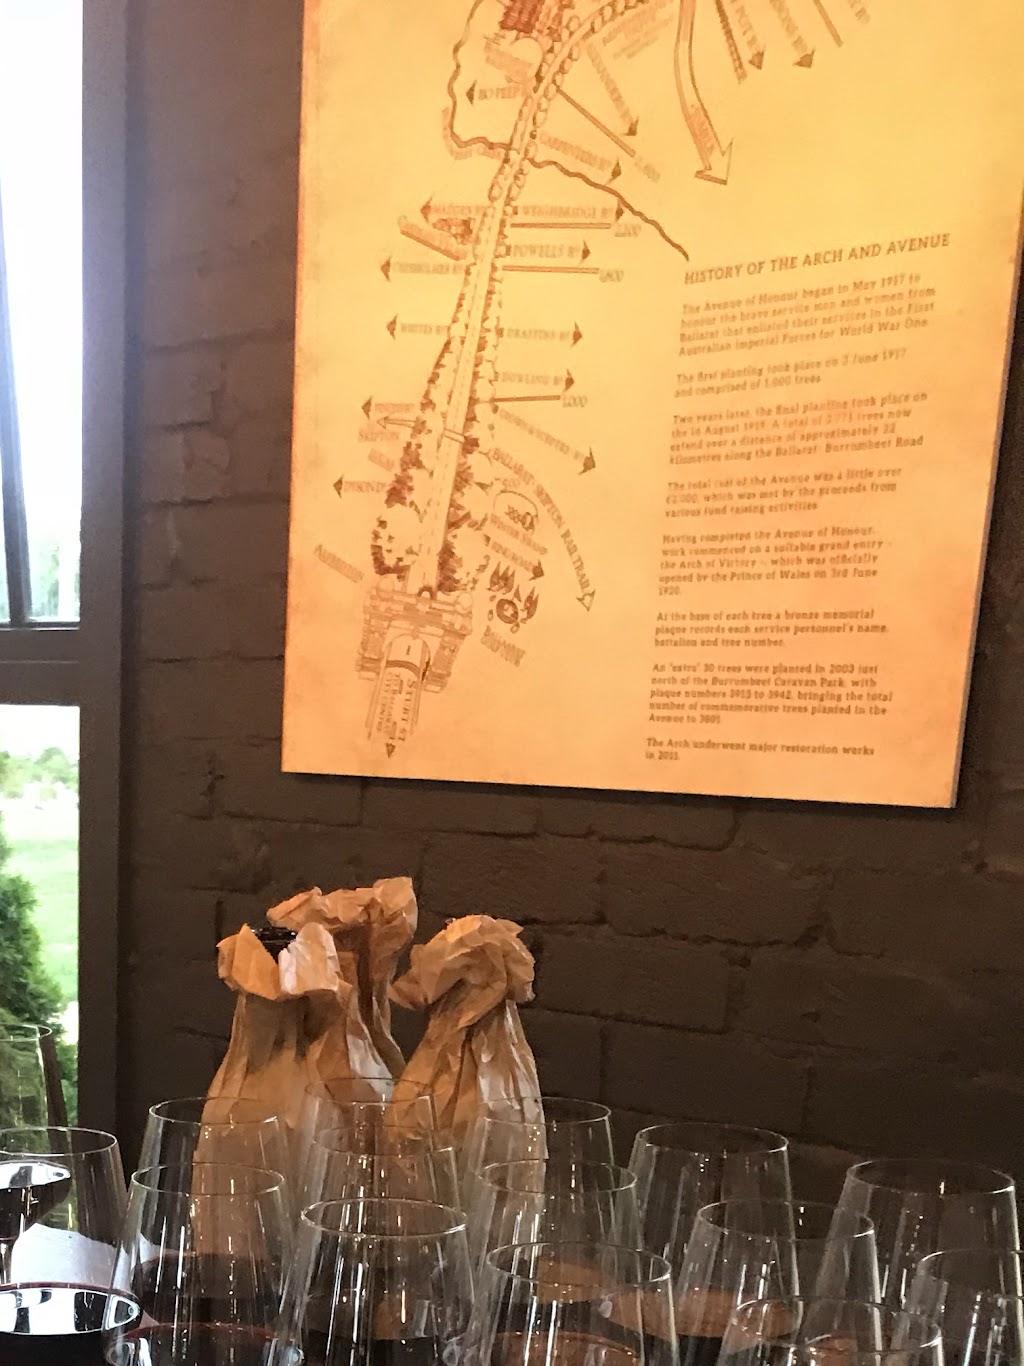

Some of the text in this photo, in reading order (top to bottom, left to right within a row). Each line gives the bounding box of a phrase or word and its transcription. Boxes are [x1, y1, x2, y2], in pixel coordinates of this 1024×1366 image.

[683, 232, 951, 285] HISTORY OF THE ARCH AND AVENUE
